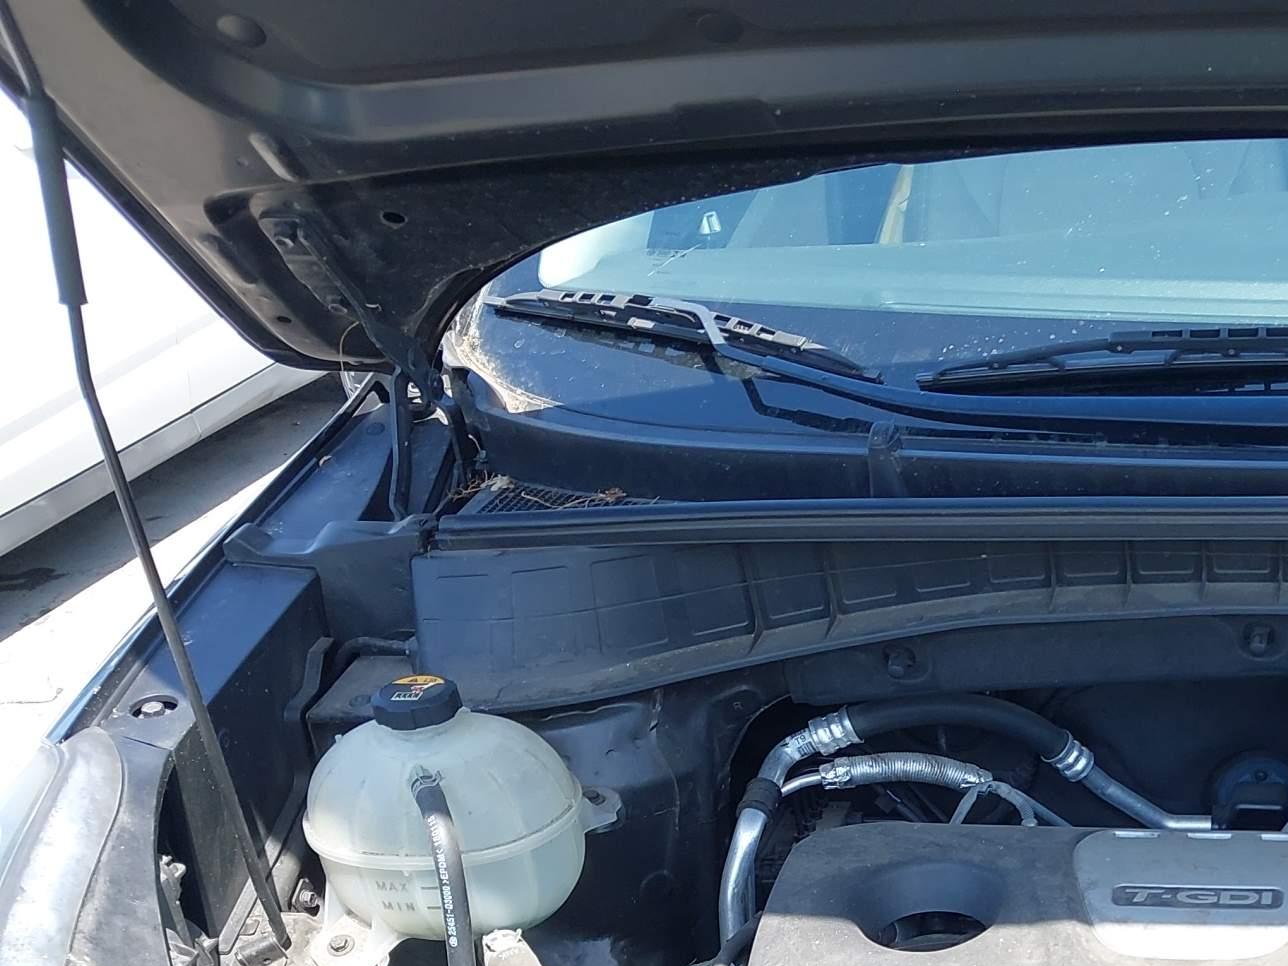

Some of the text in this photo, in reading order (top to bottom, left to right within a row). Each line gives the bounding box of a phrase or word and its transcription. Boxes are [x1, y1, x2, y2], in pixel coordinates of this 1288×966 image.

[375, 881, 408, 892] MAX
[1125, 888, 1273, 905] T-GDI
[382, 901, 415, 911] MIN
